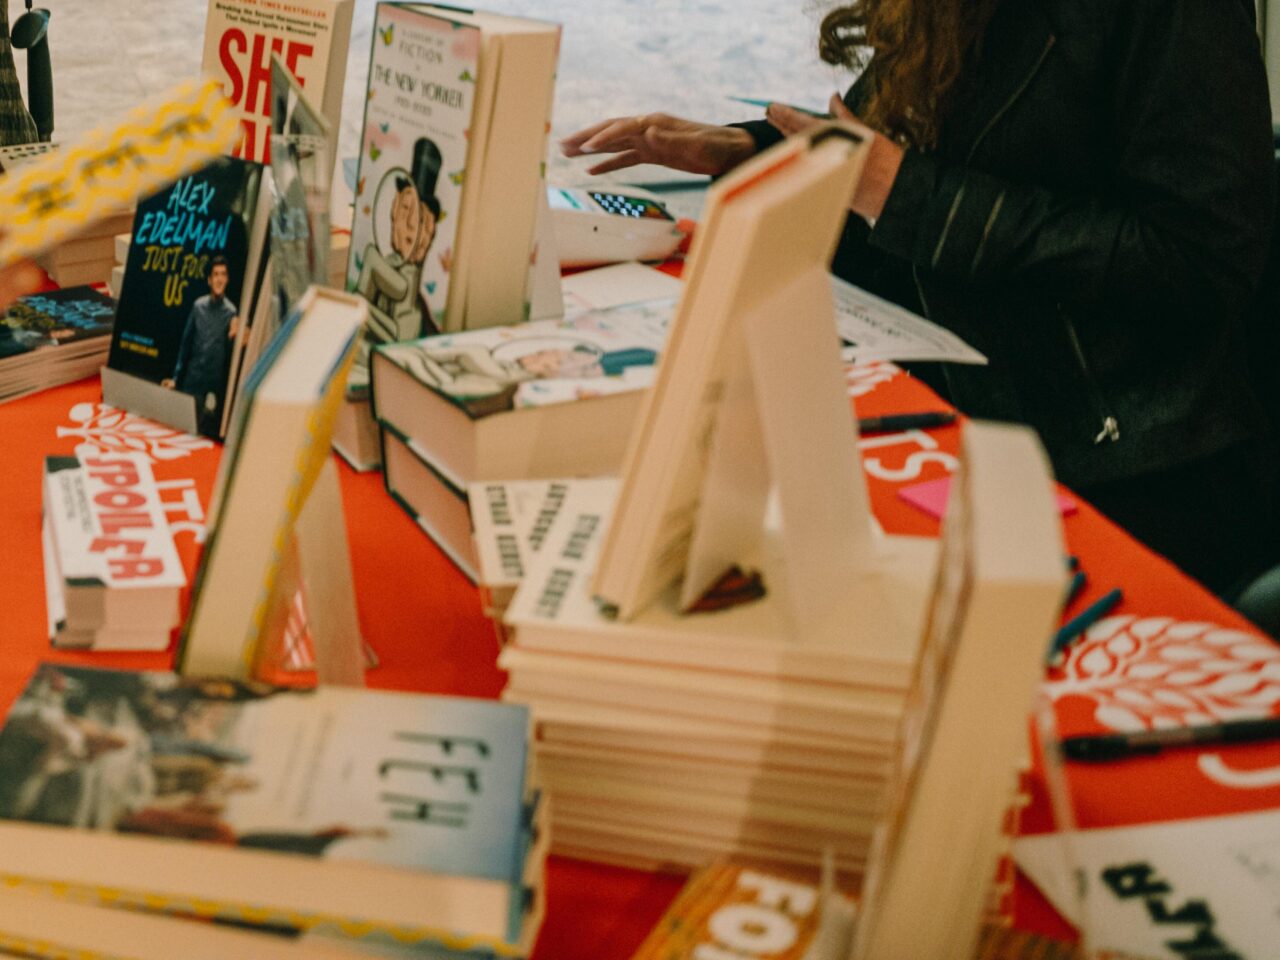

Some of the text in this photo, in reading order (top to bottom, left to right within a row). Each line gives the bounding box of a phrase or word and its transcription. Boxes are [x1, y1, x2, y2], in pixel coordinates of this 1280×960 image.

[395, 71, 417, 93] NEW
[421, 80, 464, 110] YORKER
[167, 176, 215, 215] ALEX
[136, 210, 232, 254] EDELMAN
[142, 245, 209, 279] JUST FOR
[163, 273, 189, 307] US
